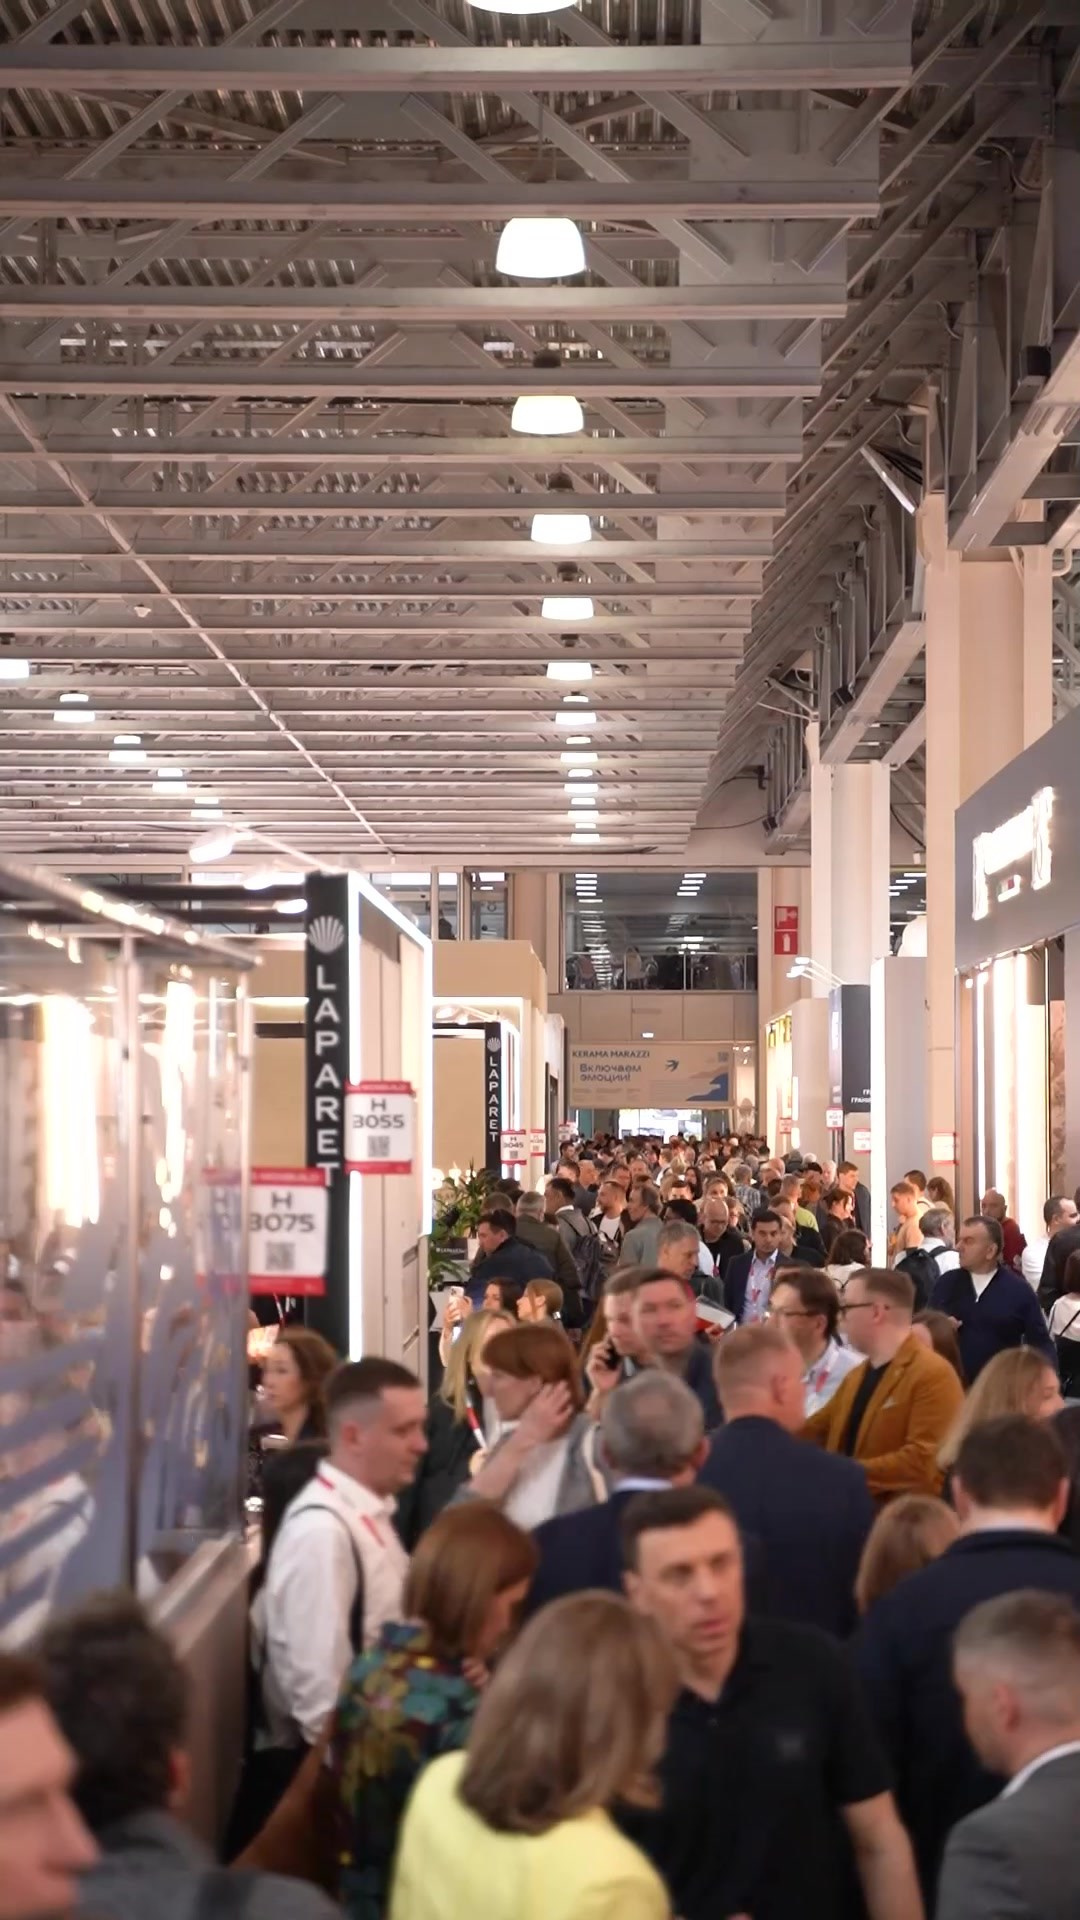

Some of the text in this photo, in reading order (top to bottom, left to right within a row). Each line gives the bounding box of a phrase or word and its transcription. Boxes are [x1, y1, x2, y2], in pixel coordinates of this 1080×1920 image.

[572, 1050, 650, 1058] KERAMA MARAZZI
[579, 1063, 642, 1073] Включаем
[314, 965, 341, 1187] LAPARET
[579, 1073, 631, 1082] эмоции!
[370, 1098, 386, 1112] H
[488, 1056, 499, 1142] LAPARET
[352, 1114, 405, 1129] 3055
[271, 1191, 293, 1209] H
[249, 1213, 315, 1233] 3075
